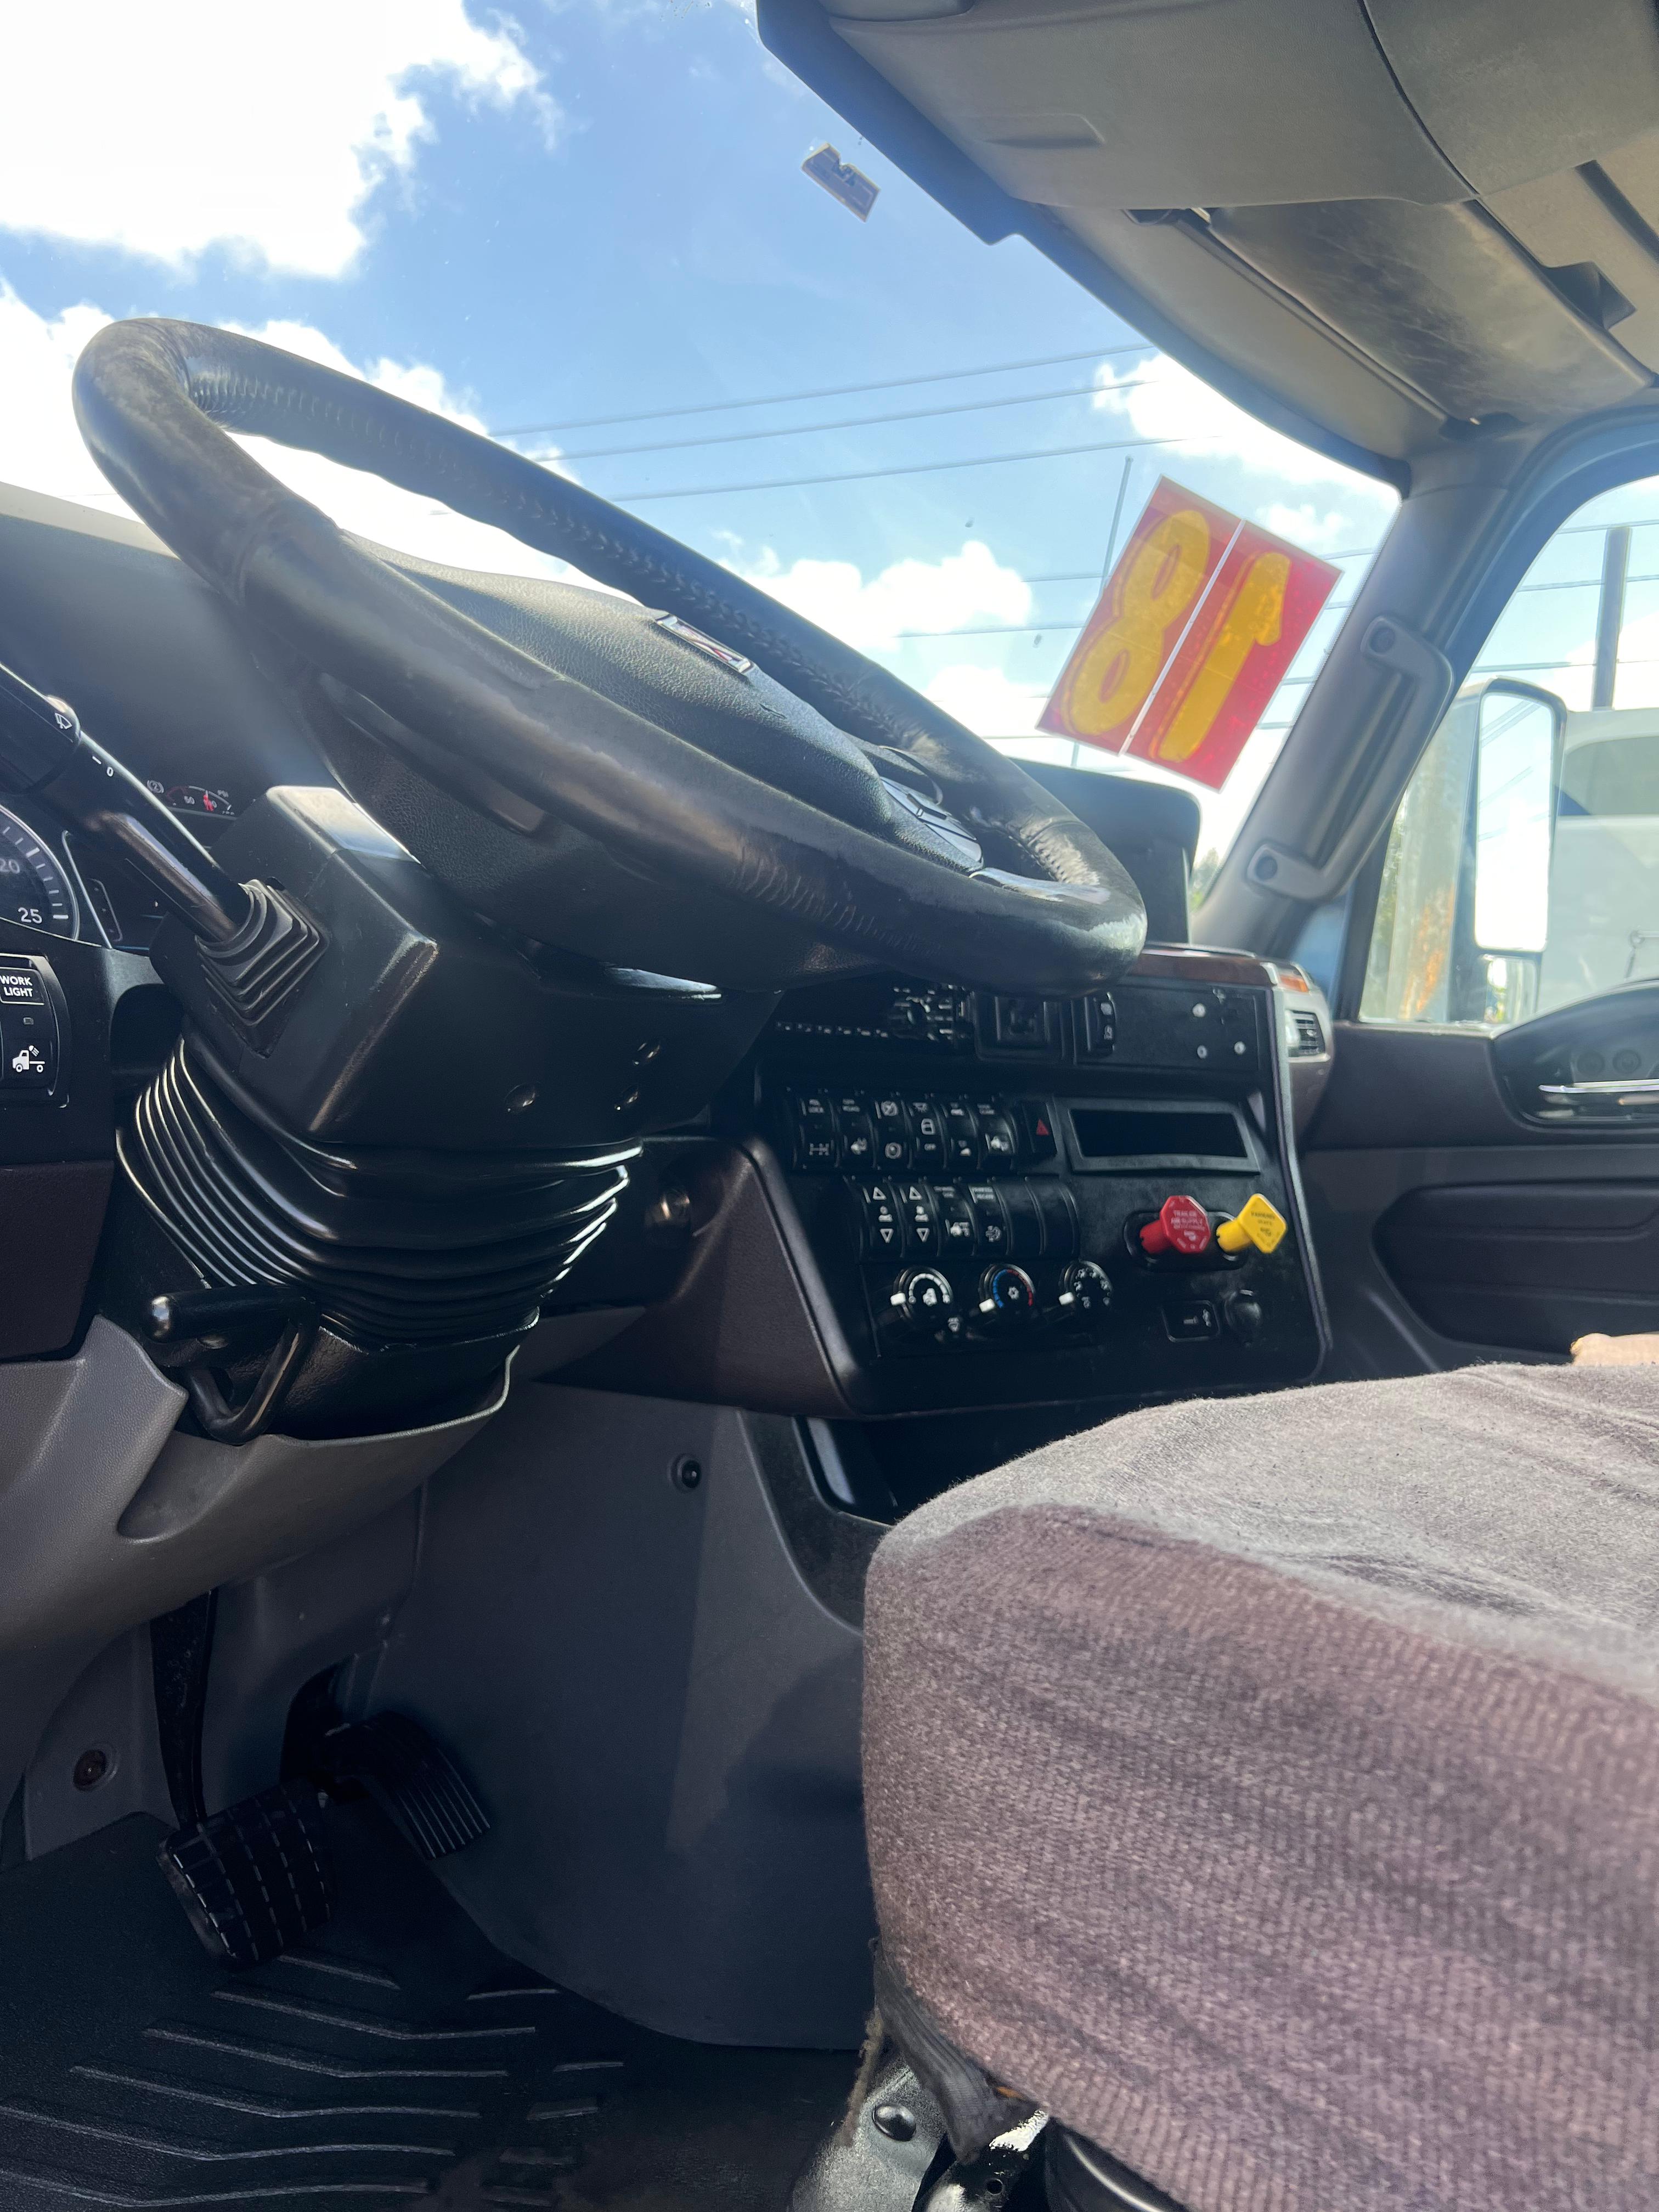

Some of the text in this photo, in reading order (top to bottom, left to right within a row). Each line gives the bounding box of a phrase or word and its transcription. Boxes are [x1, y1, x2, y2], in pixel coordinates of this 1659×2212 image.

[18, 907, 43, 924] 25
[0, 975, 33, 986] WORK
[3, 986, 33, 997] LIGHT
